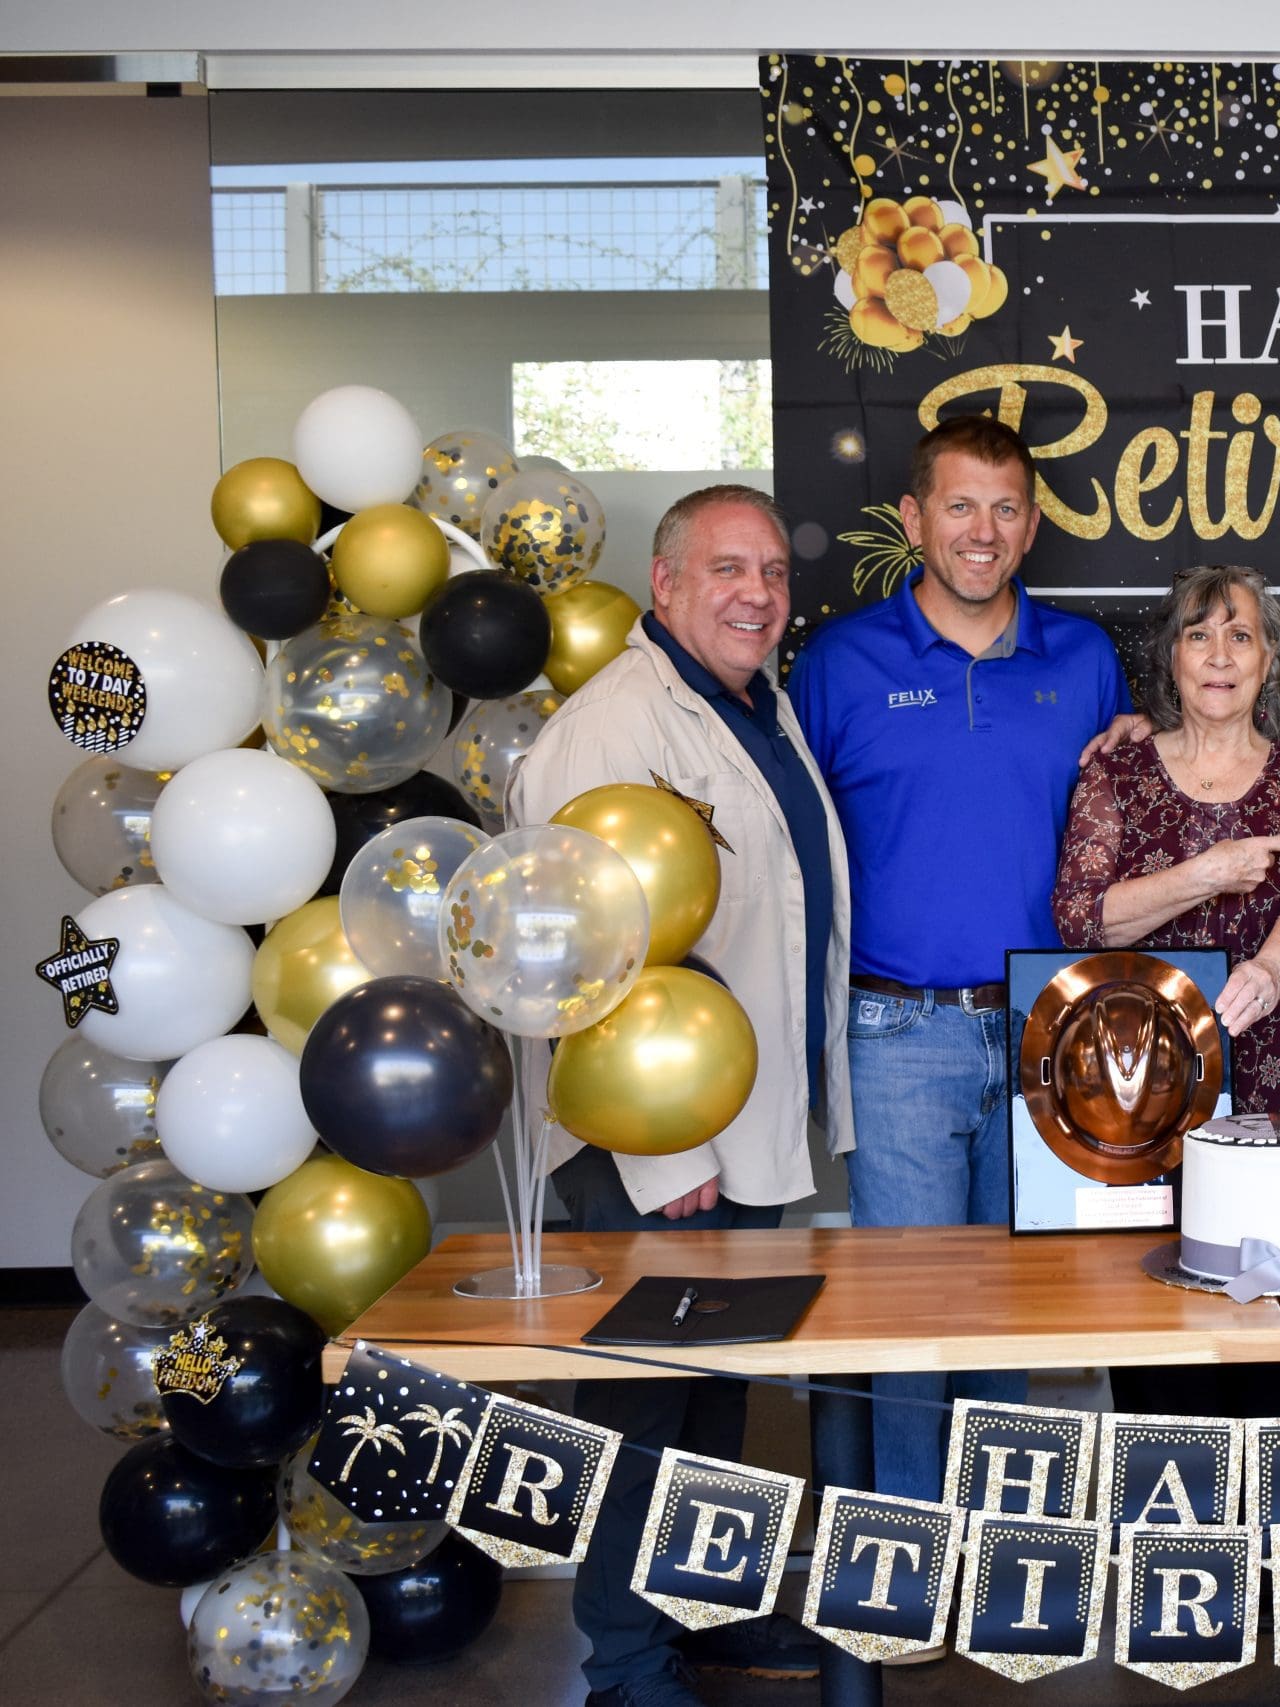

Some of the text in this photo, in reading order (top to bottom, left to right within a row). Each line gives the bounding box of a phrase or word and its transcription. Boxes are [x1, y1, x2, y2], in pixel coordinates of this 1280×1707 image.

[67, 650, 134, 680] WELCOME
[67, 666, 132, 696] TO 7 DAY
[62, 681, 134, 714] WEEKENDS
[888, 689, 937, 707] FELIX
[45, 943, 109, 978] OFFICIALLY
[61, 965, 108, 994] RETIRED
[175, 1352, 213, 1374] HELLO
[157, 1368, 218, 1394] FREEDOM
